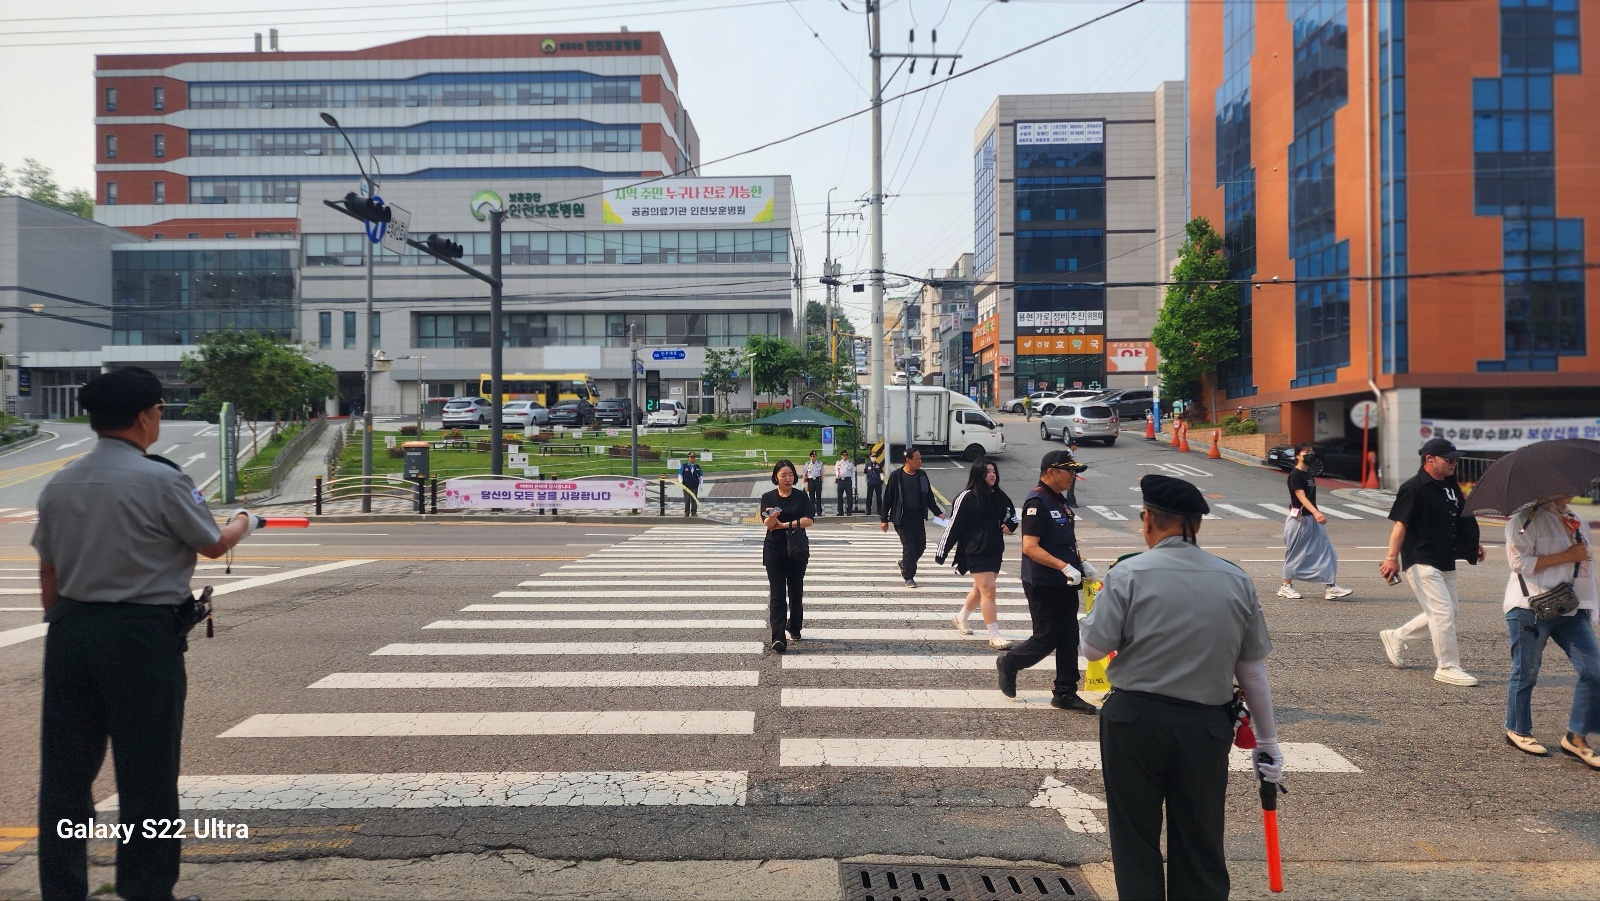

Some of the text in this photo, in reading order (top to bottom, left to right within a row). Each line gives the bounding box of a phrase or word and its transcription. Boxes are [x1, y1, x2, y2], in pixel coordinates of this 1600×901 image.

[508, 192, 542, 202] 보훈공단
[615, 185, 763, 200] 지역 주민 누구나 진료 가능한
[509, 203, 585, 218] 인천보훈병원
[631, 206, 746, 217] 공공의료기관 인천보훈병원
[1001, 357, 1009, 365] 약
[647, 399, 659, 410] 21
[481, 490, 612, 500] 당신의 모든 날을 사랑합니다
